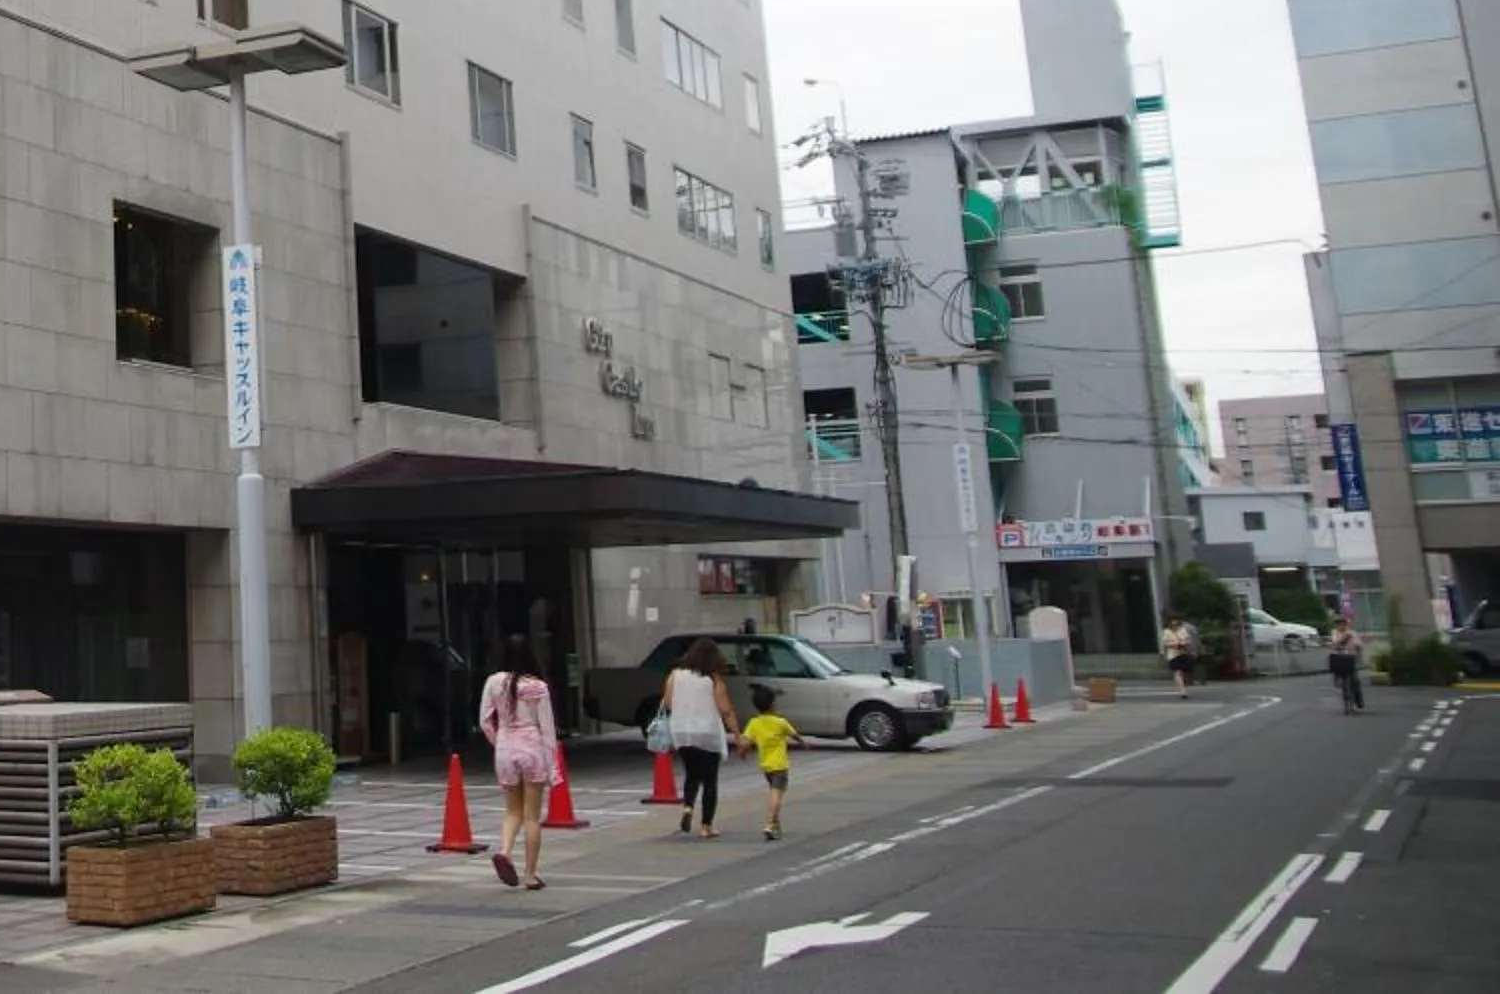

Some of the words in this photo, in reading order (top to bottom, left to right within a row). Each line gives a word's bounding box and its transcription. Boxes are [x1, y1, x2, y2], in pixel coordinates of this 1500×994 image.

[229, 274, 252, 444] 岐阜キャッスルイン
